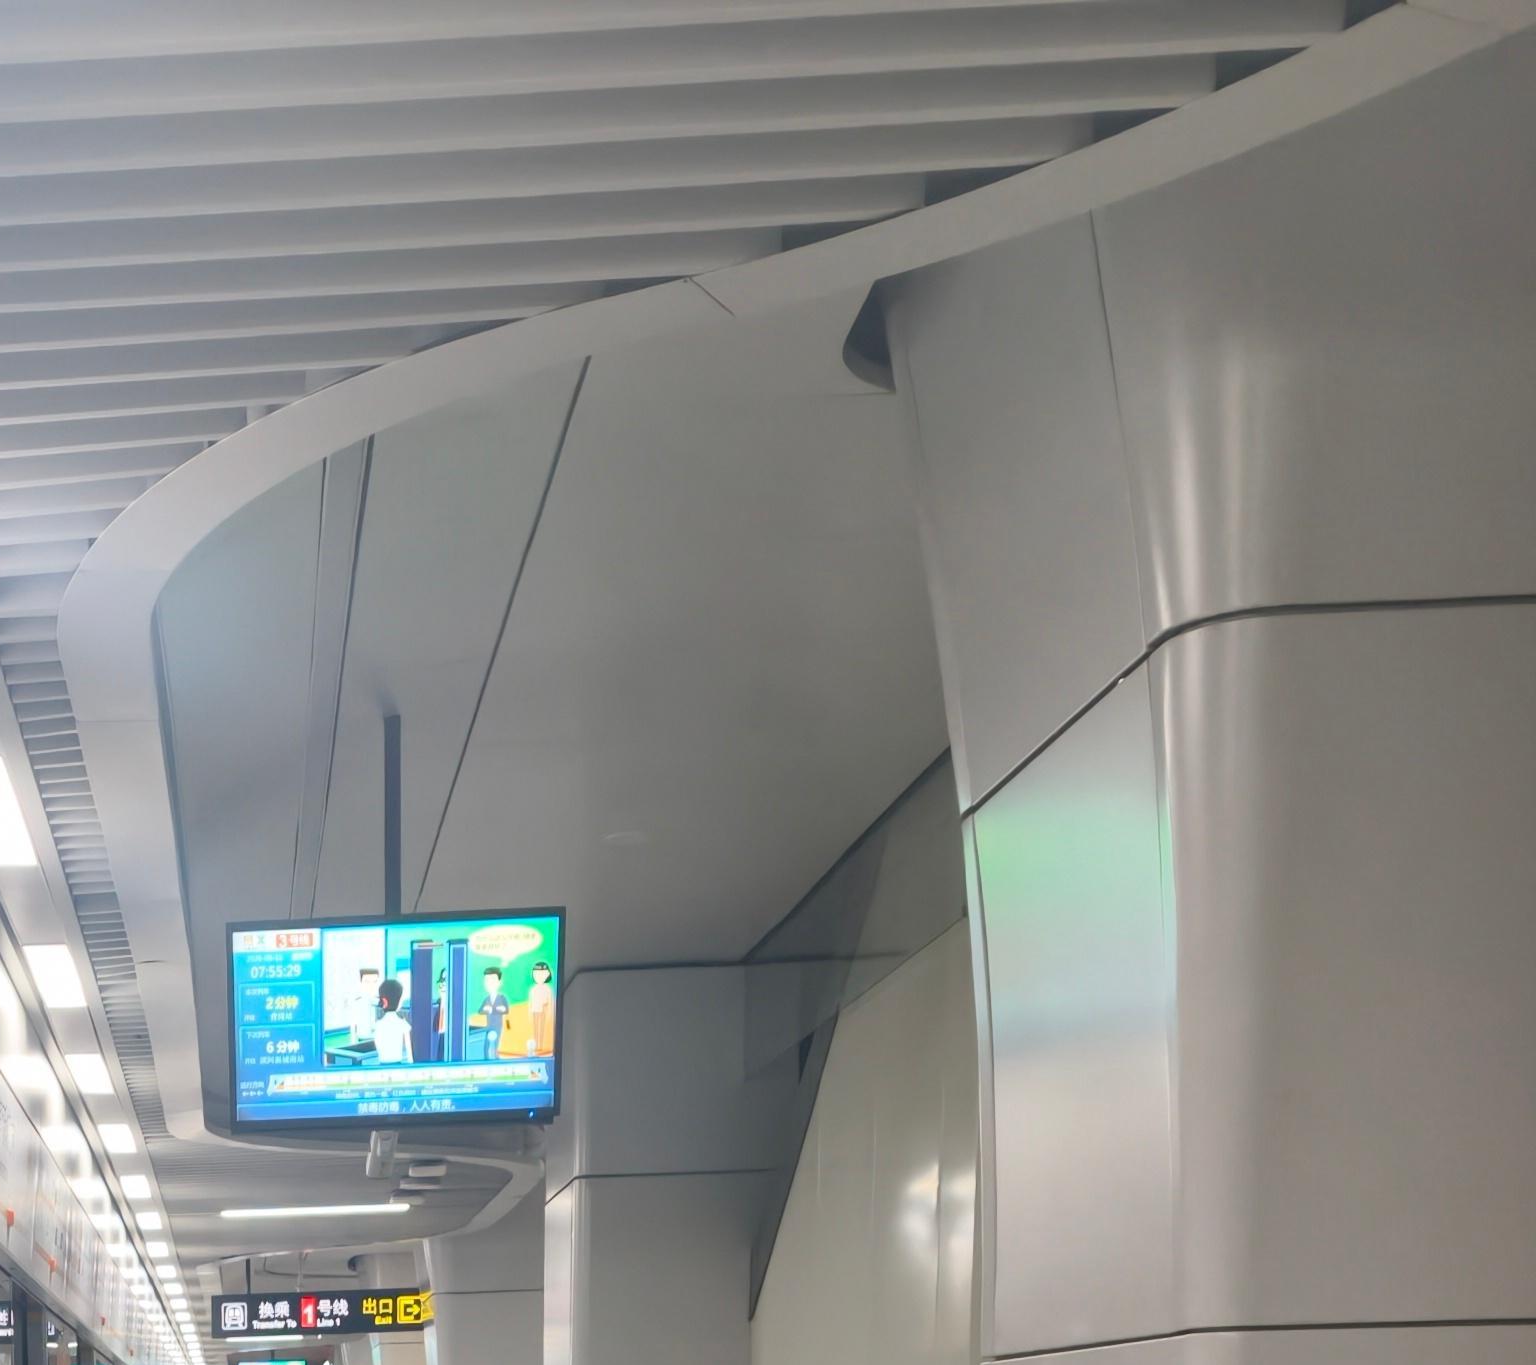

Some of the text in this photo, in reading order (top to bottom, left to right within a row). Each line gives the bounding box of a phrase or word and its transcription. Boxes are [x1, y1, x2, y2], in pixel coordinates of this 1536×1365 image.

[250, 964, 301, 978] 07:55:29
[265, 995, 299, 1010] 2分钟
[266, 1040, 300, 1054] 6分钟
[258, 1301, 290, 1319] 换乘
[362, 1298, 393, 1316] 出口
[252, 1320, 285, 1330] Transfer
[286, 1319, 298, 1329] To
[317, 1319, 334, 1328] Line
[375, 1314, 393, 1325] Exit
